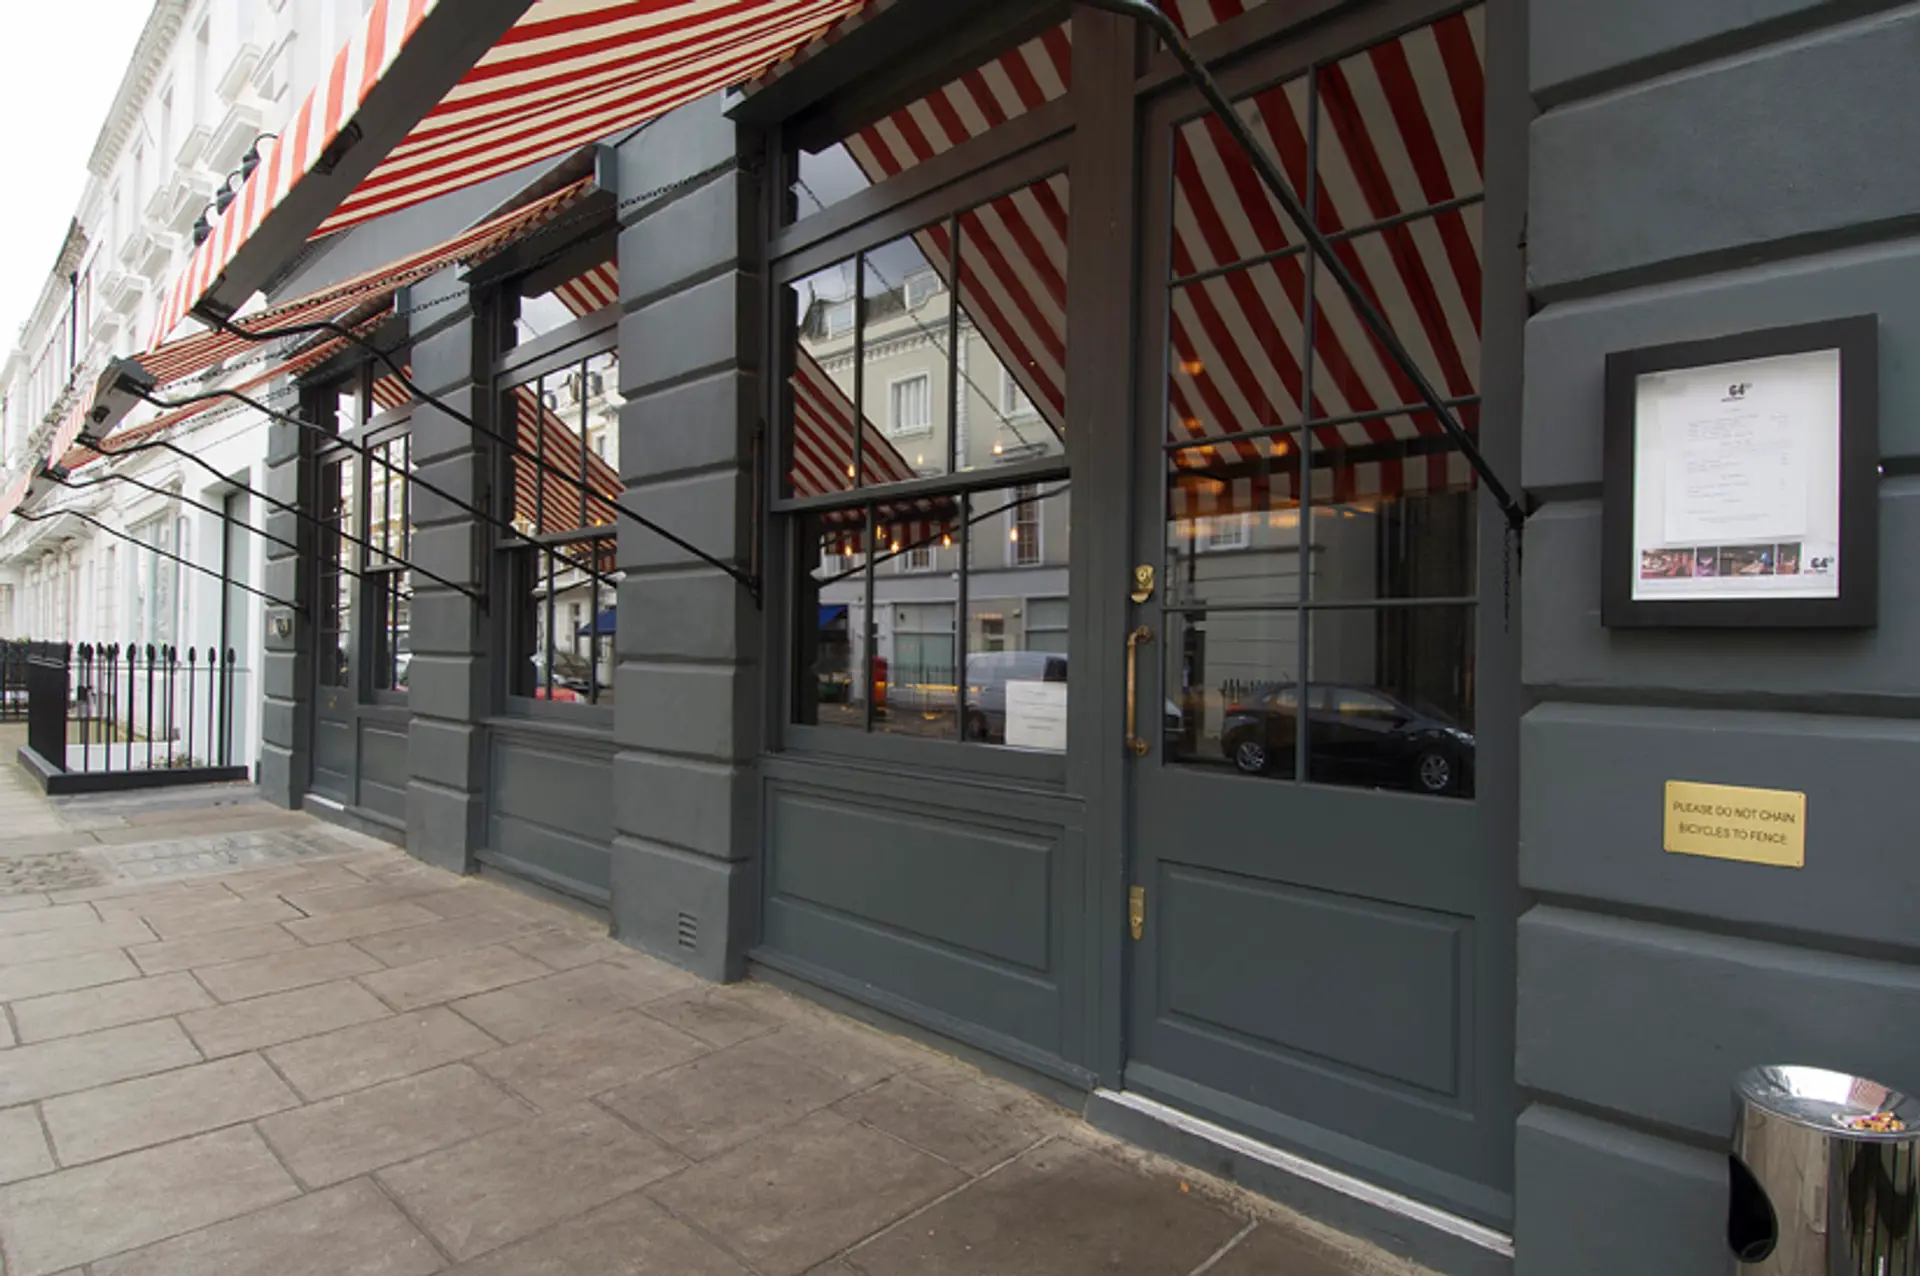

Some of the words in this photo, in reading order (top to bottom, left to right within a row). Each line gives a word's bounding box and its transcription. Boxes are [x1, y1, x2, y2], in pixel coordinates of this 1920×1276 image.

[1673, 801, 1713, 816] PLEASE
[1715, 805, 1732, 818] DO
[1734, 808, 1757, 820] NOT
[1759, 810, 1796, 824] CHAIN
[1679, 822, 1730, 839] BICYCLES
[1732, 828, 1749, 841] TO
[1750, 830, 1788, 845] FENCE
